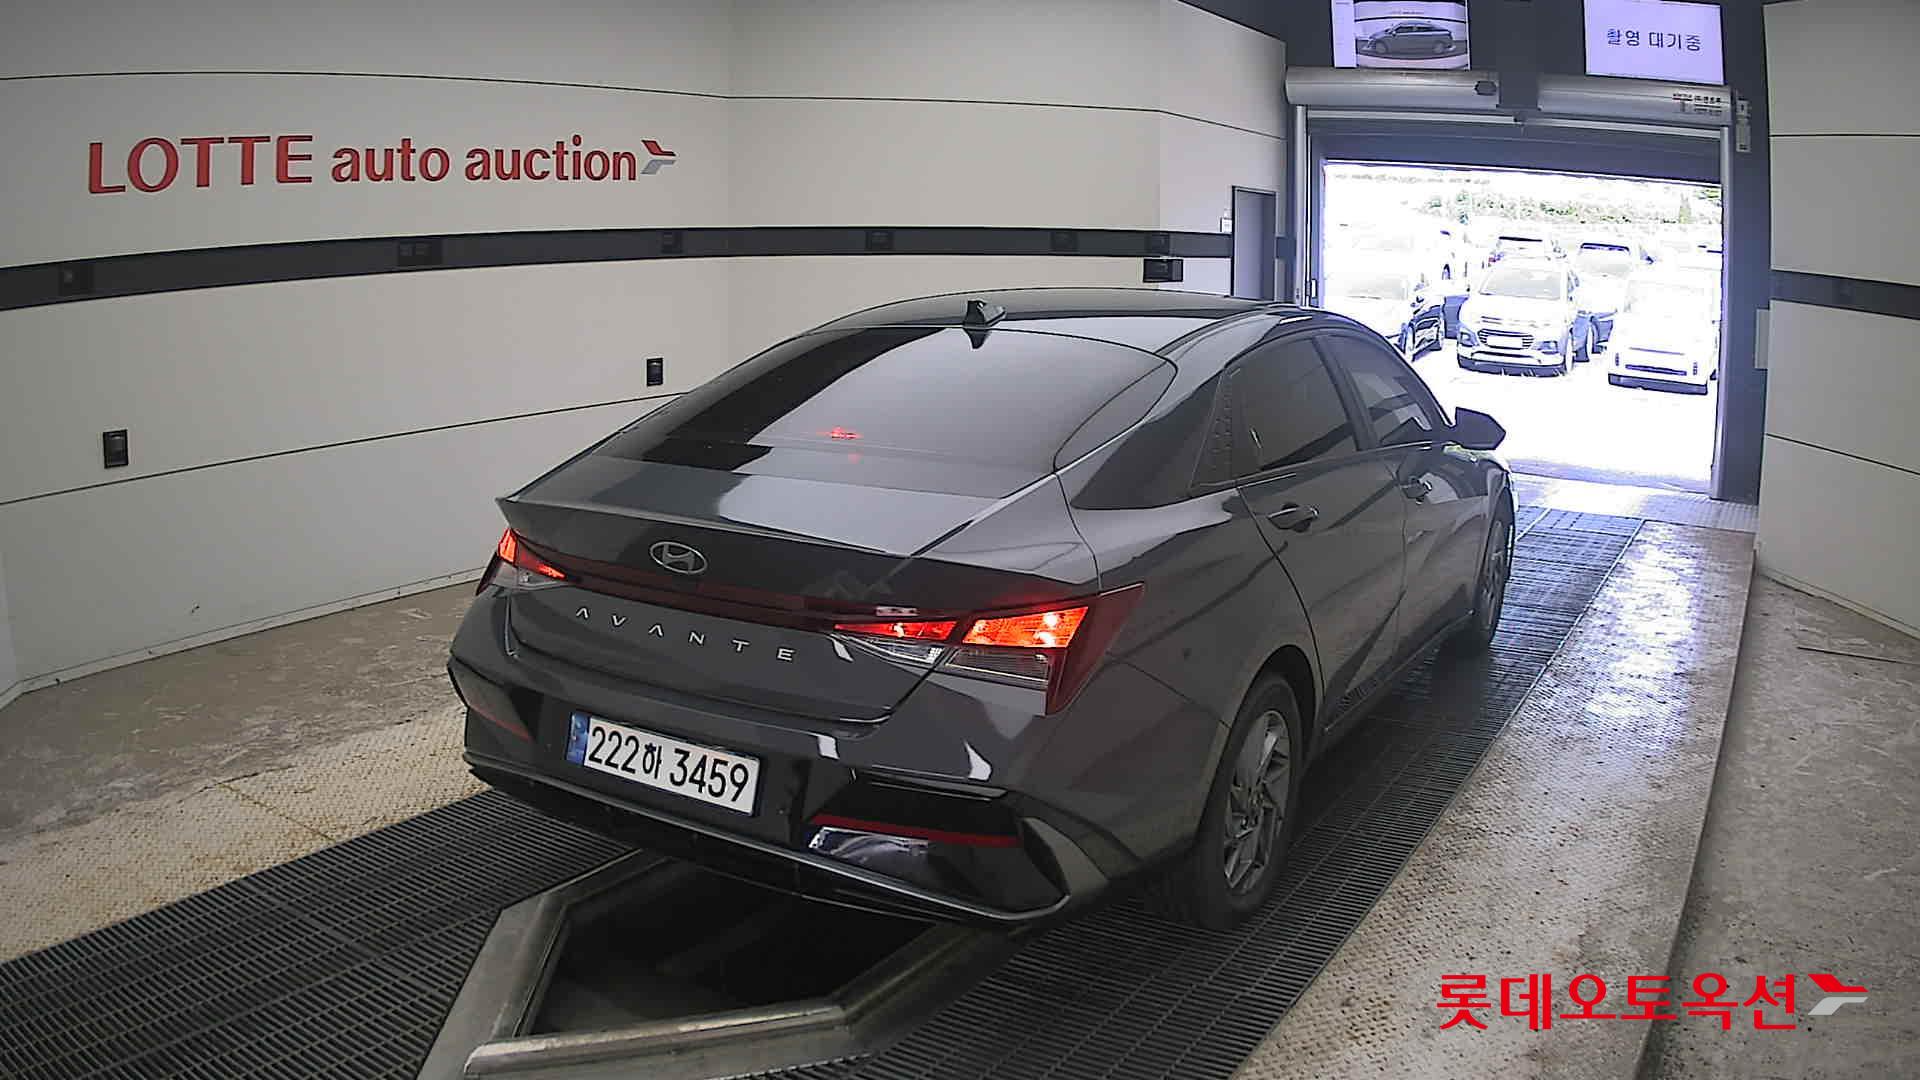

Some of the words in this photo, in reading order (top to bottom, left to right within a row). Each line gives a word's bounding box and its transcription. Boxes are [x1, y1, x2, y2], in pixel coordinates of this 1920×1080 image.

[1648, 31, 1702, 52] 대기중
[88, 134, 314, 194] LOTTE
[331, 138, 450, 182] auto
[464, 134, 637, 182] auction
[576, 606, 795, 662] AVANTE
[588, 726, 662, 780] 222하
[669, 748, 750, 802] 3459
